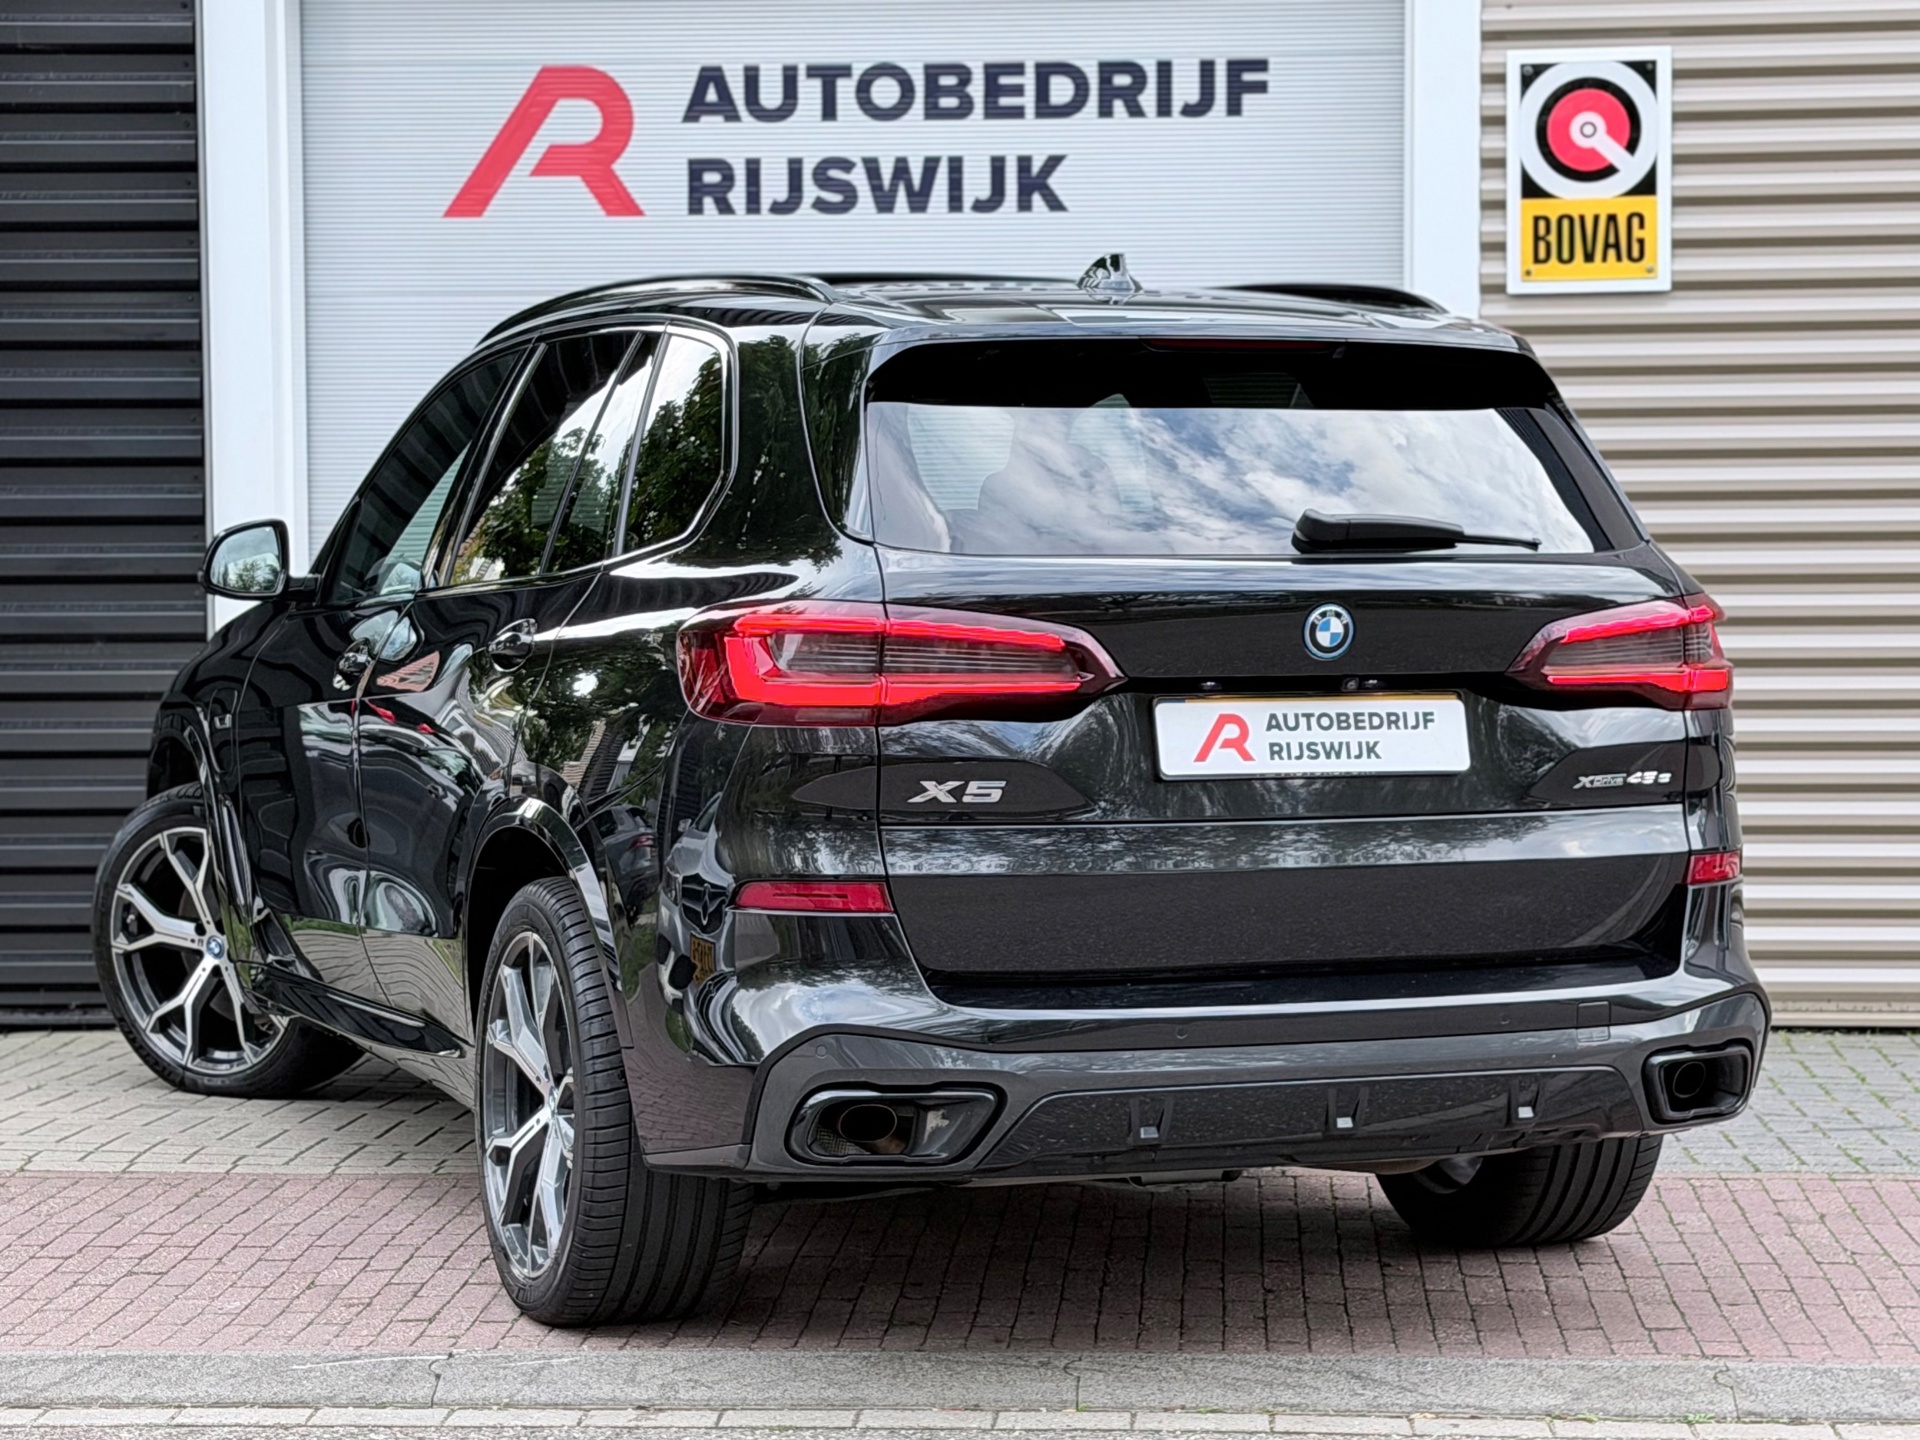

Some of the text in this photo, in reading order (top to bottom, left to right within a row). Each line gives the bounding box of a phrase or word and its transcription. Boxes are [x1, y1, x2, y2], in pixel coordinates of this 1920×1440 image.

[682, 59, 1269, 123] AUTOBEDRIJF
[687, 154, 1067, 215] RIJSWIJK
[1533, 212, 1646, 265] BOVAG
[1266, 711, 1435, 732] AUTOBEDRIJF
[1269, 741, 1382, 761] RIJSWIJK
[907, 780, 1007, 804] X5
